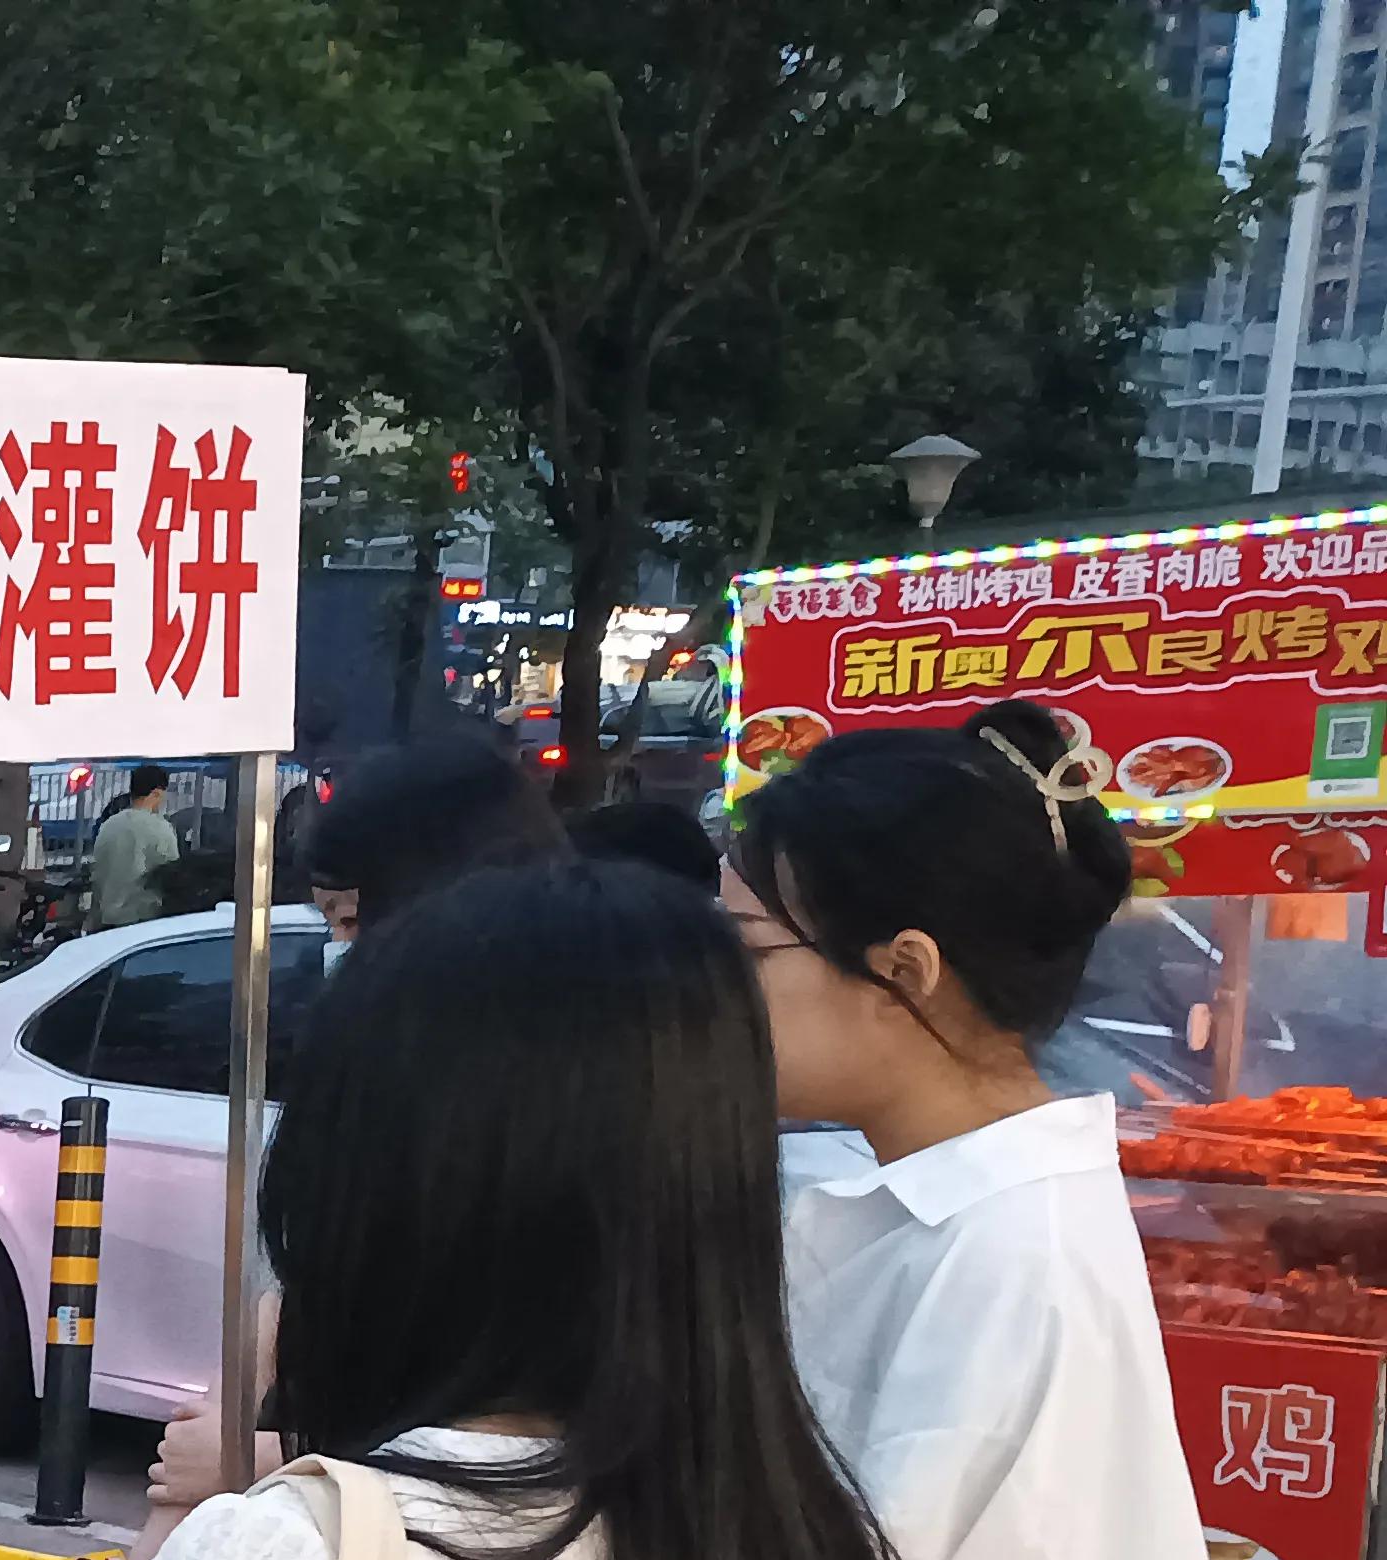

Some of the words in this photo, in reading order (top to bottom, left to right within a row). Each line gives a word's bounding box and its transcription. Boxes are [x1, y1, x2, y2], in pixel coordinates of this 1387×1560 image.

[898, 562, 1053, 614] 秘制烤鸡
[1069, 545, 1243, 599] 皮香肉脆
[1213, 1383, 1336, 1499] 鸡
